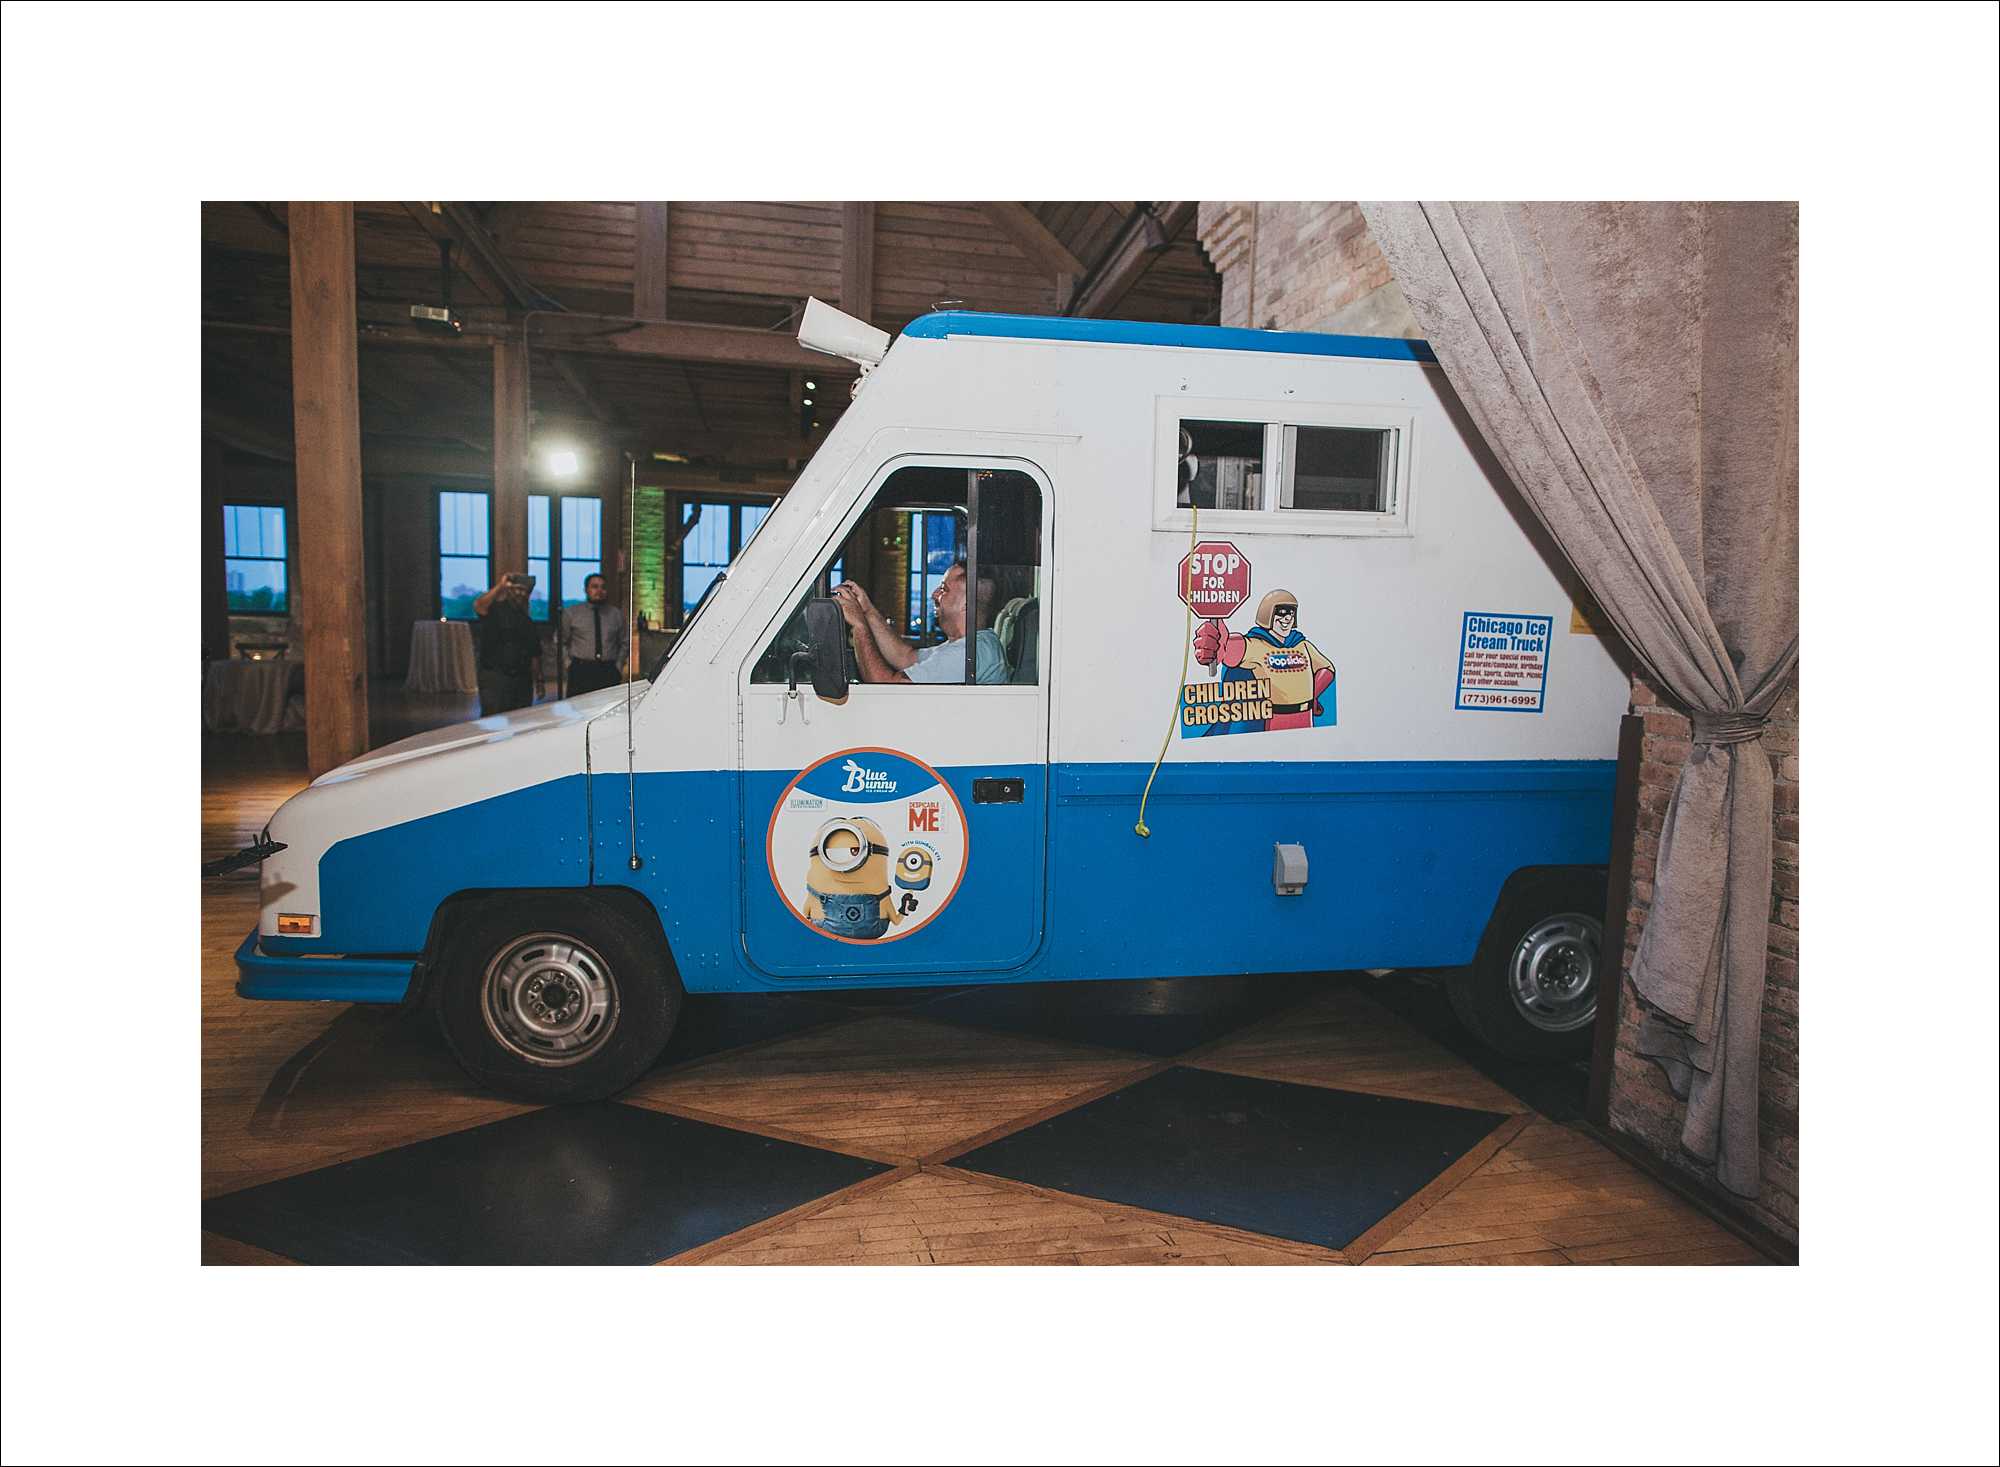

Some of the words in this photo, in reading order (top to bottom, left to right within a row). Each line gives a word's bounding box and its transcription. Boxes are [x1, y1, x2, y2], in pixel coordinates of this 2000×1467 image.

[1191, 553, 1240, 575] STOP
[1202, 576, 1225, 589] FOR
[1468, 617, 1523, 636] Chicago
[1525, 620, 1546, 636] Ice
[1468, 634, 1508, 651] Cream
[1510, 636, 1544, 652] Truck
[1184, 678, 1271, 705] CHILDREN
[1463, 694, 1537, 705] (773)961-6995
[1183, 699, 1273, 727] CROSSING
[842, 760, 888, 786] Blue
[842, 770, 897, 793] Bunny
[909, 808, 939, 832] ME
